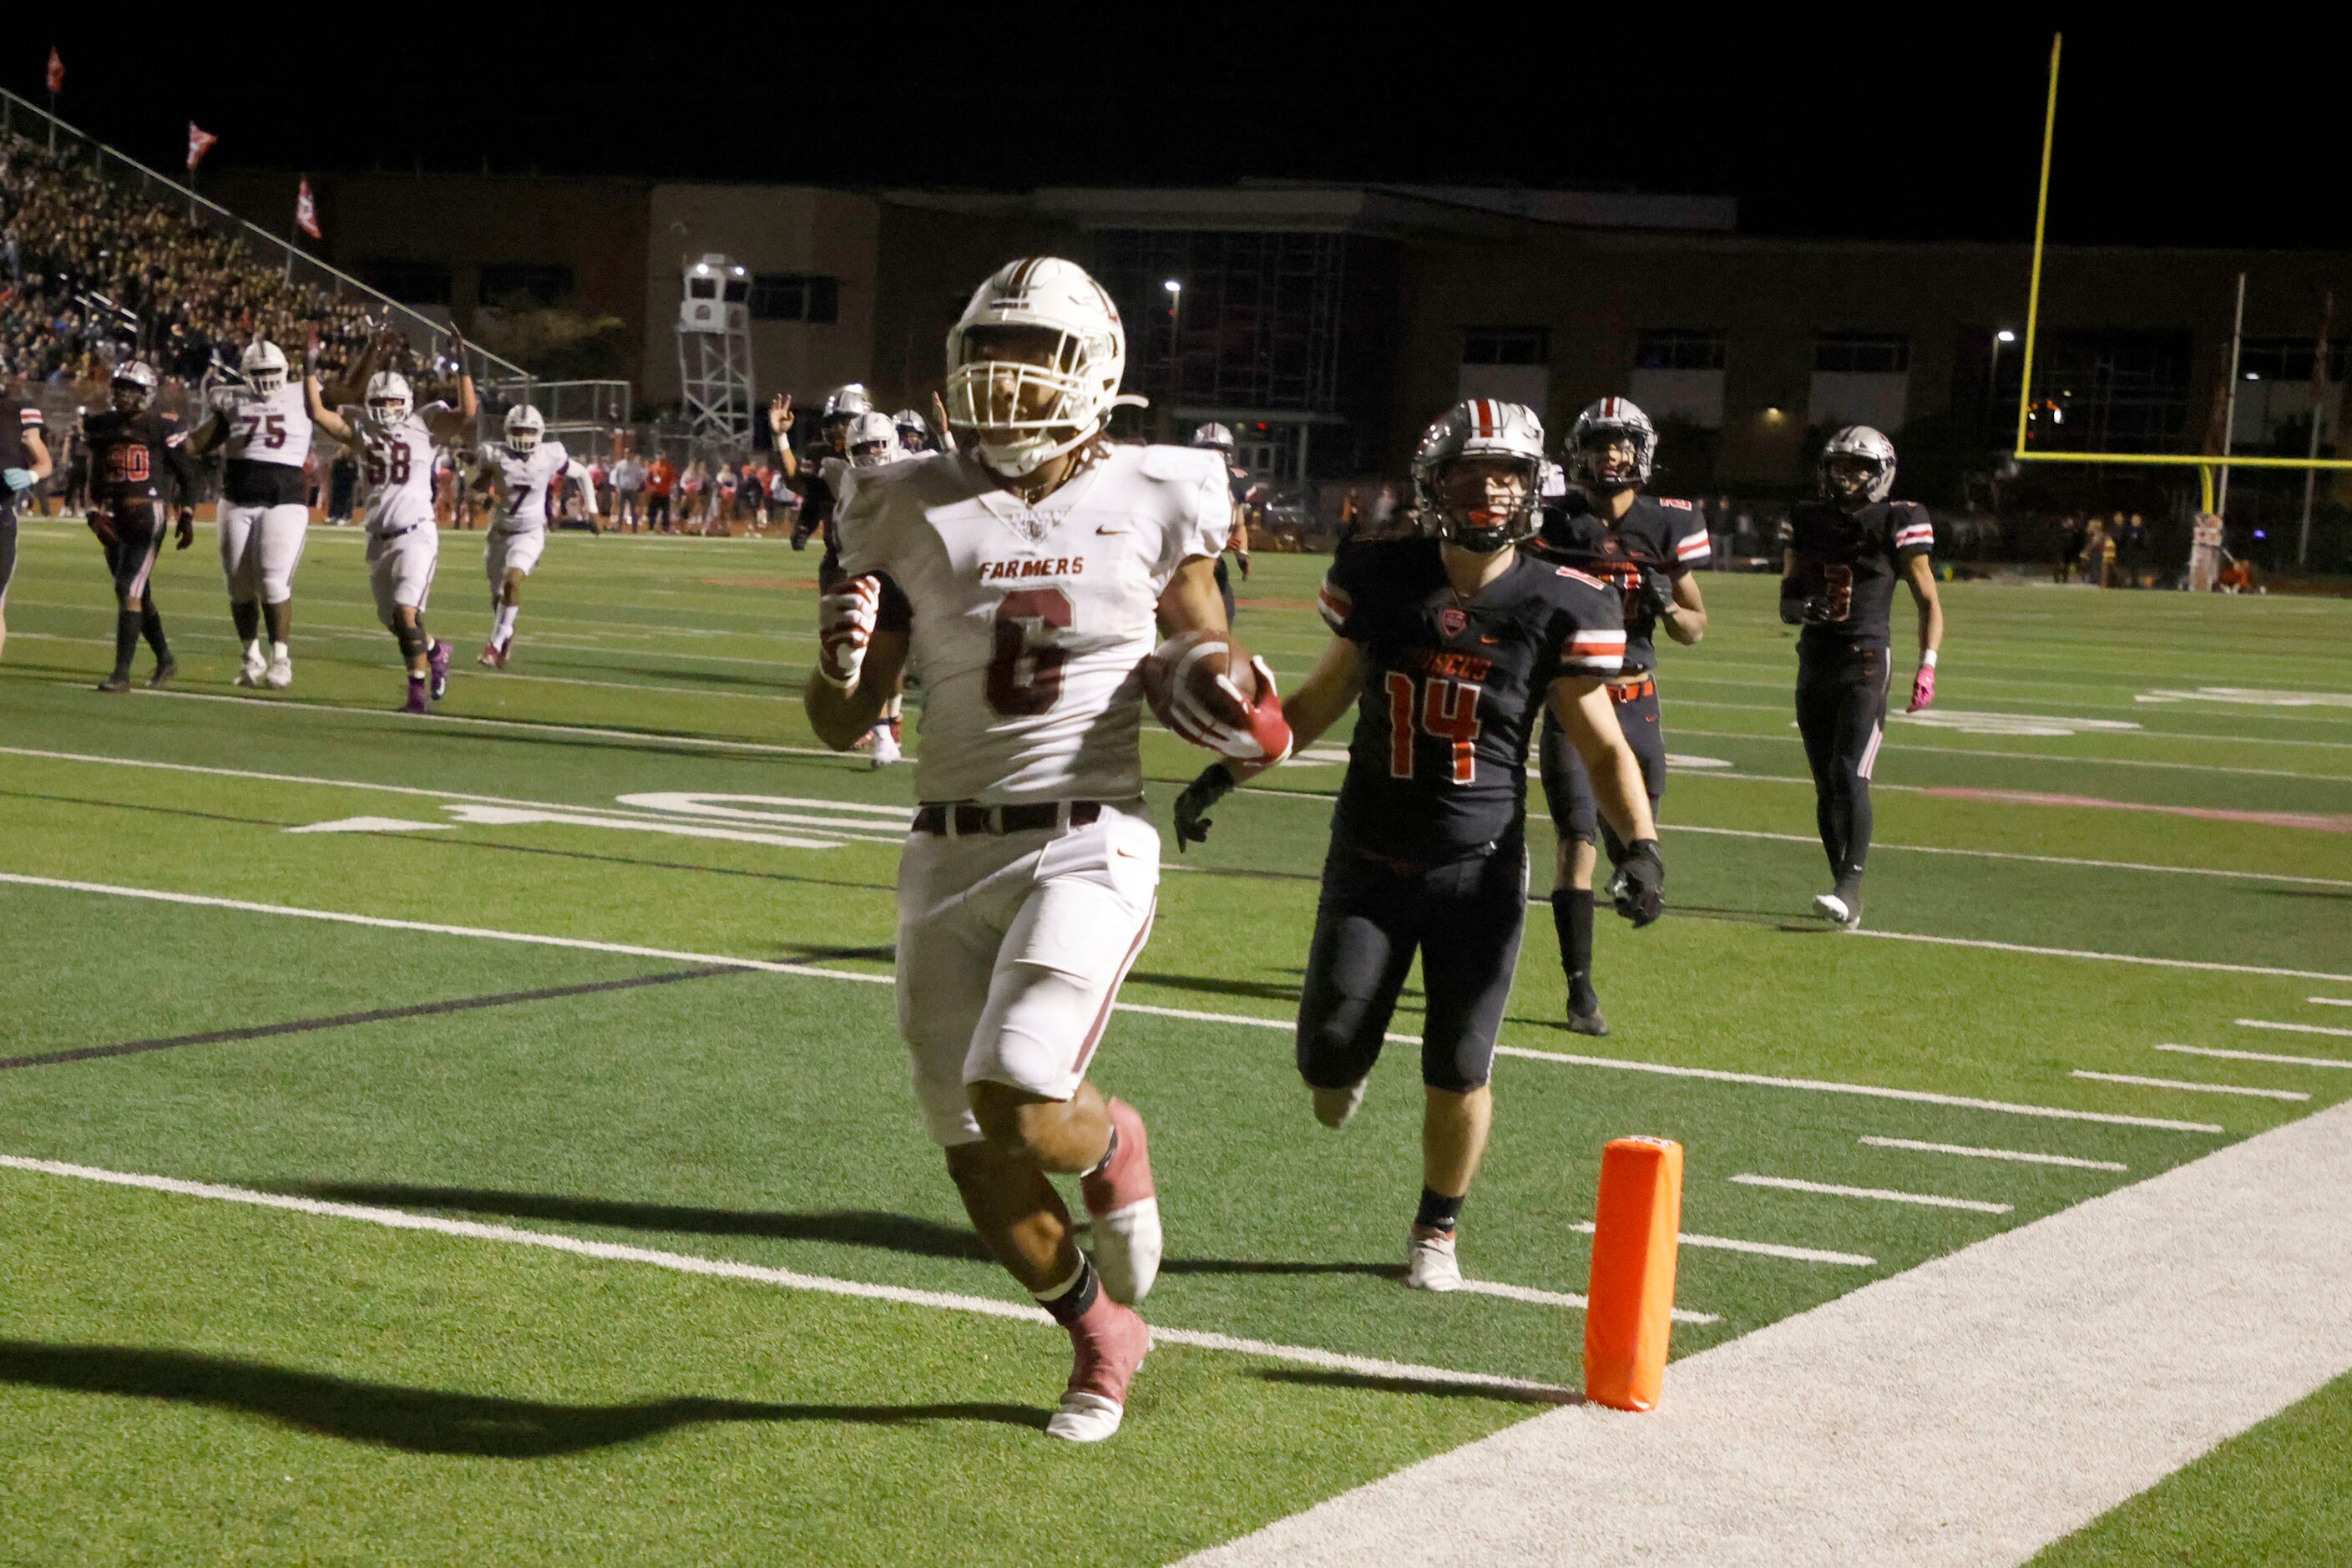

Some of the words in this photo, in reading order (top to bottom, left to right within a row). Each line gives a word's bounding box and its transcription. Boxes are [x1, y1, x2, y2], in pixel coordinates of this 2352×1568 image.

[241, 414, 287, 449] 75
[508, 483, 532, 517] 7
[979, 556, 1085, 580] FARMERS
[1385, 670, 1482, 786] 14
